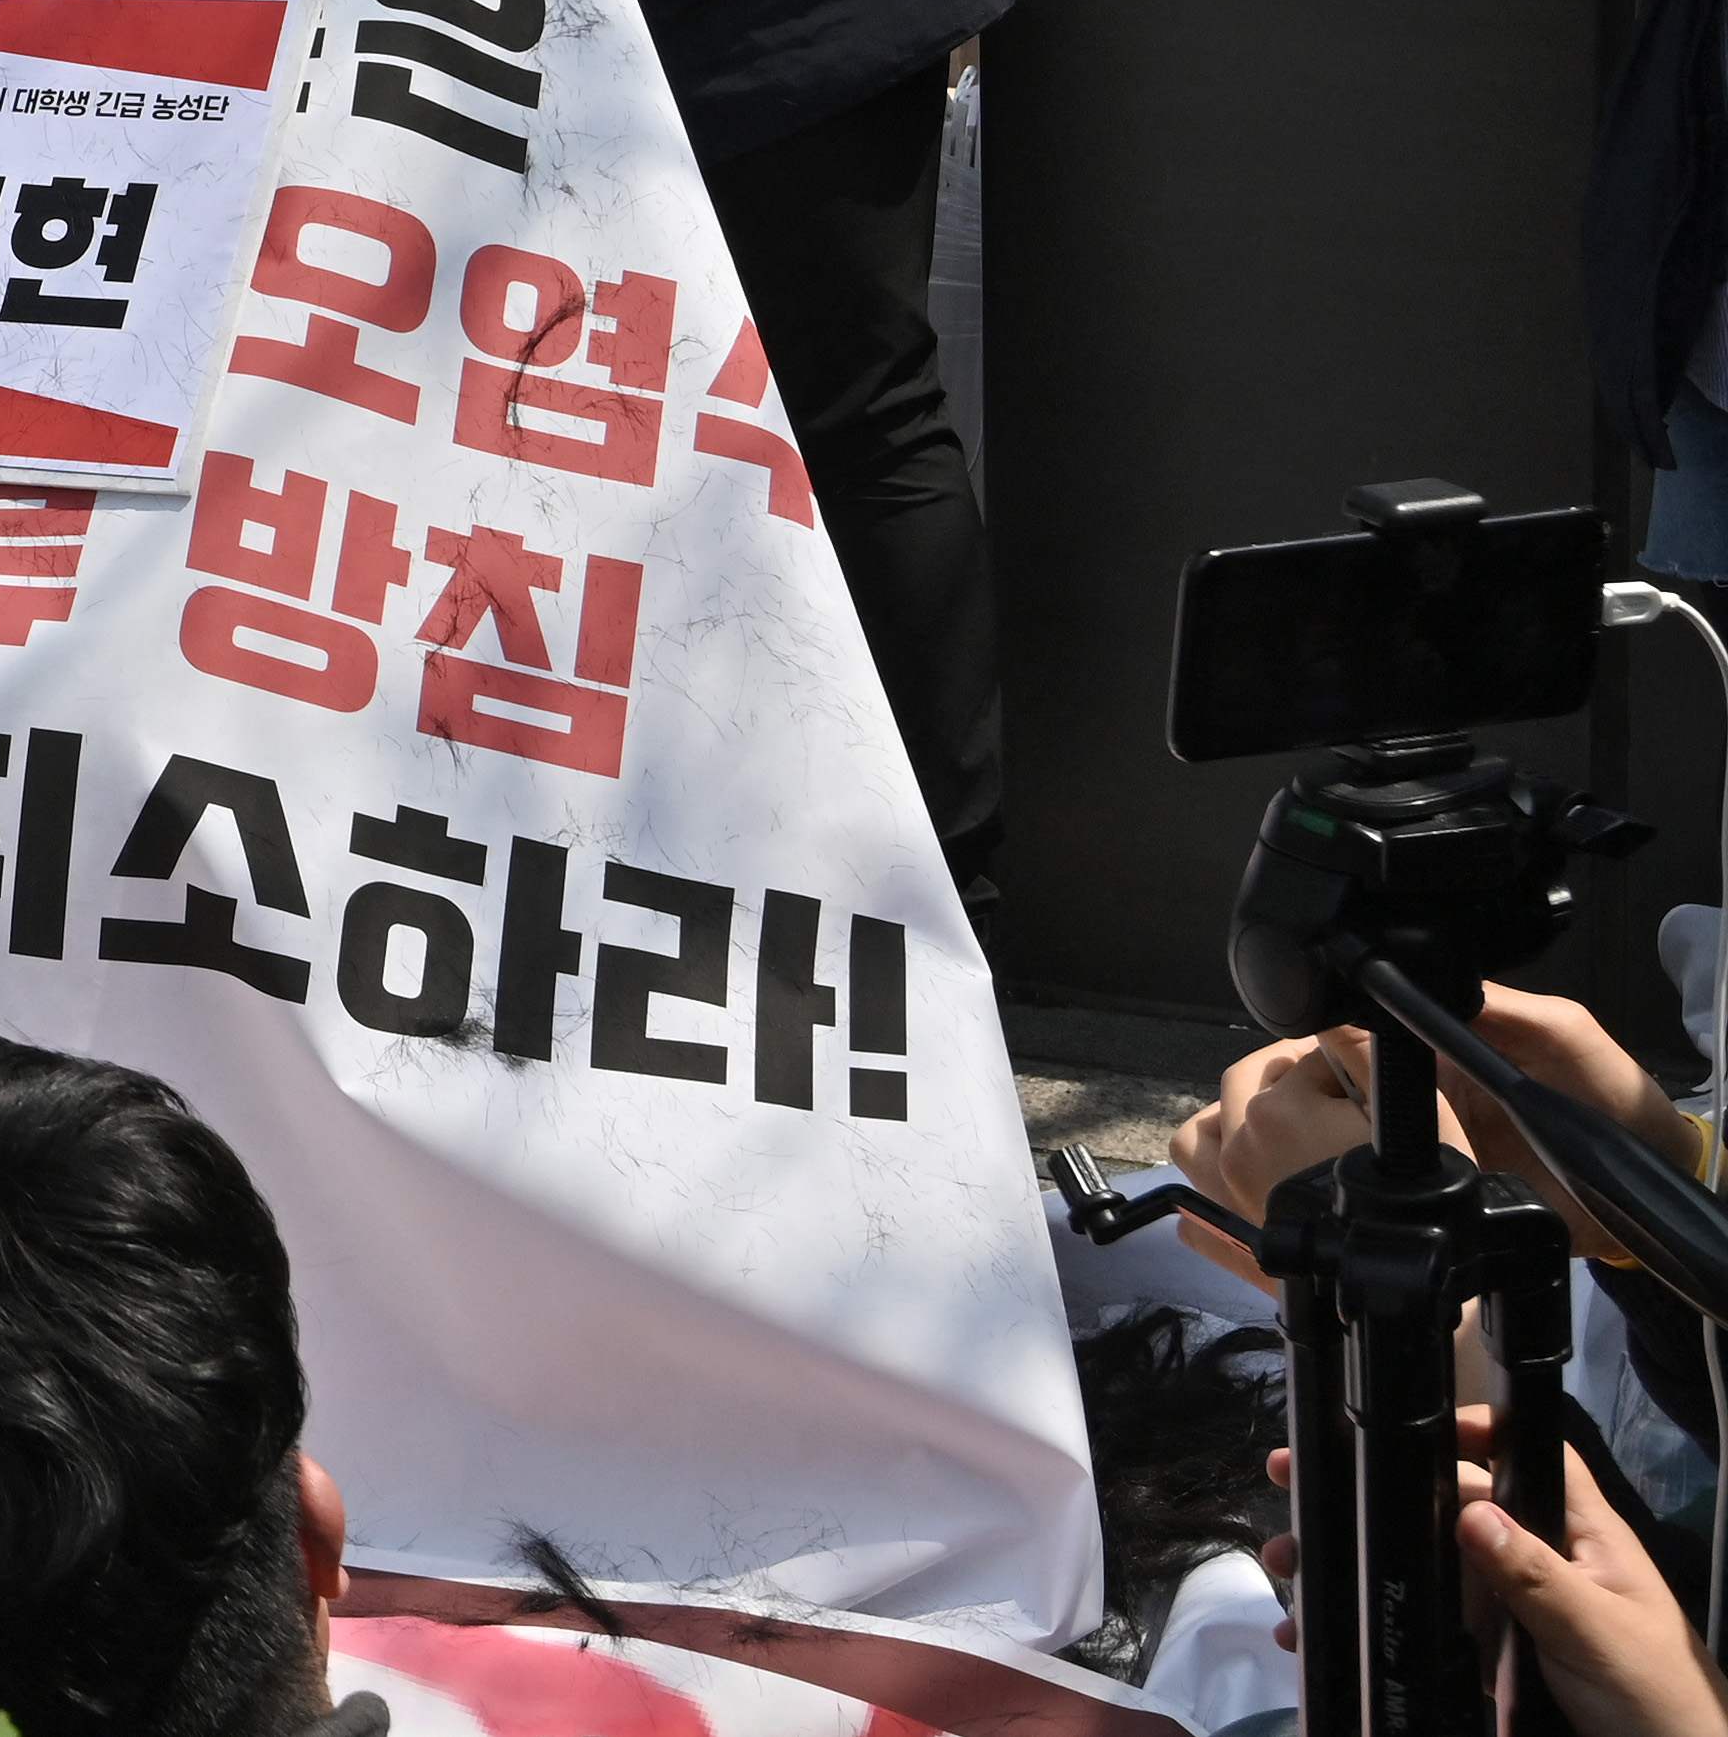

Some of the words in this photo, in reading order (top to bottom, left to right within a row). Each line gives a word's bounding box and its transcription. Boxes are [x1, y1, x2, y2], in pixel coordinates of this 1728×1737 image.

[11, 87, 90, 118] 대학생
[94, 90, 146, 120] 긴급
[151, 92, 231, 123] 농성단
[179, 450, 642, 779] 방침
